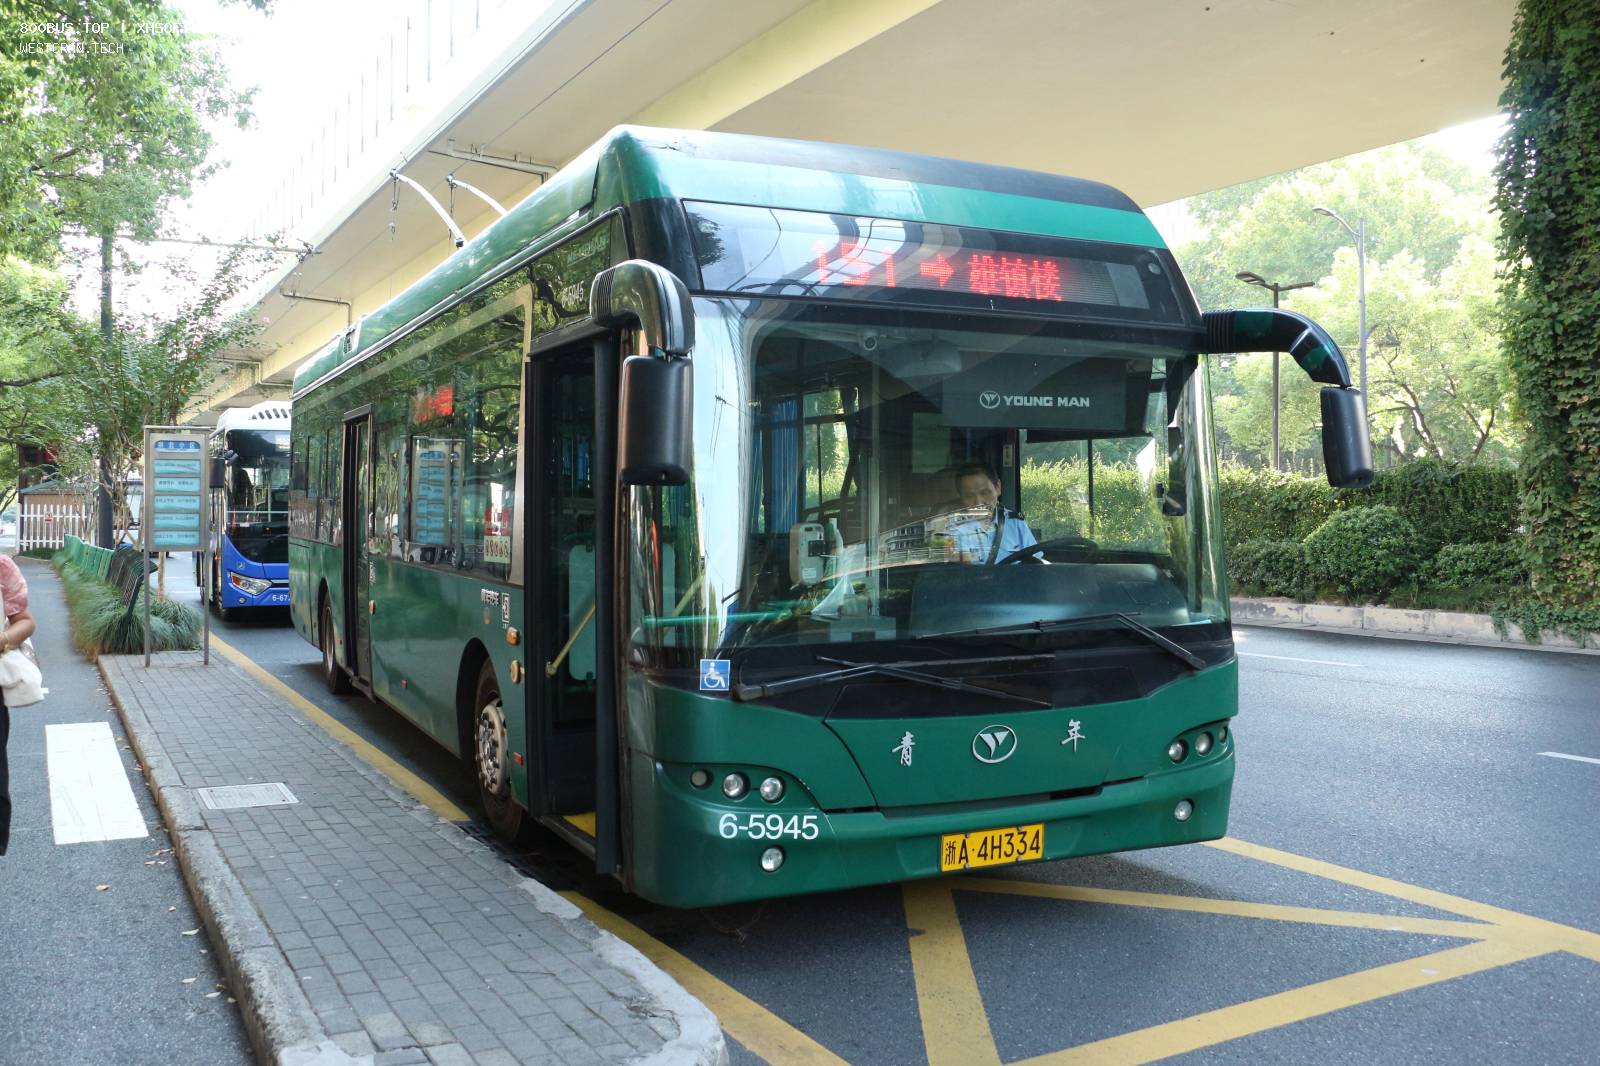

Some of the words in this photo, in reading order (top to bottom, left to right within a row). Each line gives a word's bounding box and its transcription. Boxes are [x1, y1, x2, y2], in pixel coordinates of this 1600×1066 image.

[968, 254, 1063, 301] 雄镇楼
[1003, 395, 1053, 407] YOUNG
[1057, 396, 1090, 407] MAN
[272, 594, 290, 602] 6-67
[719, 813, 819, 840] 6-5945
